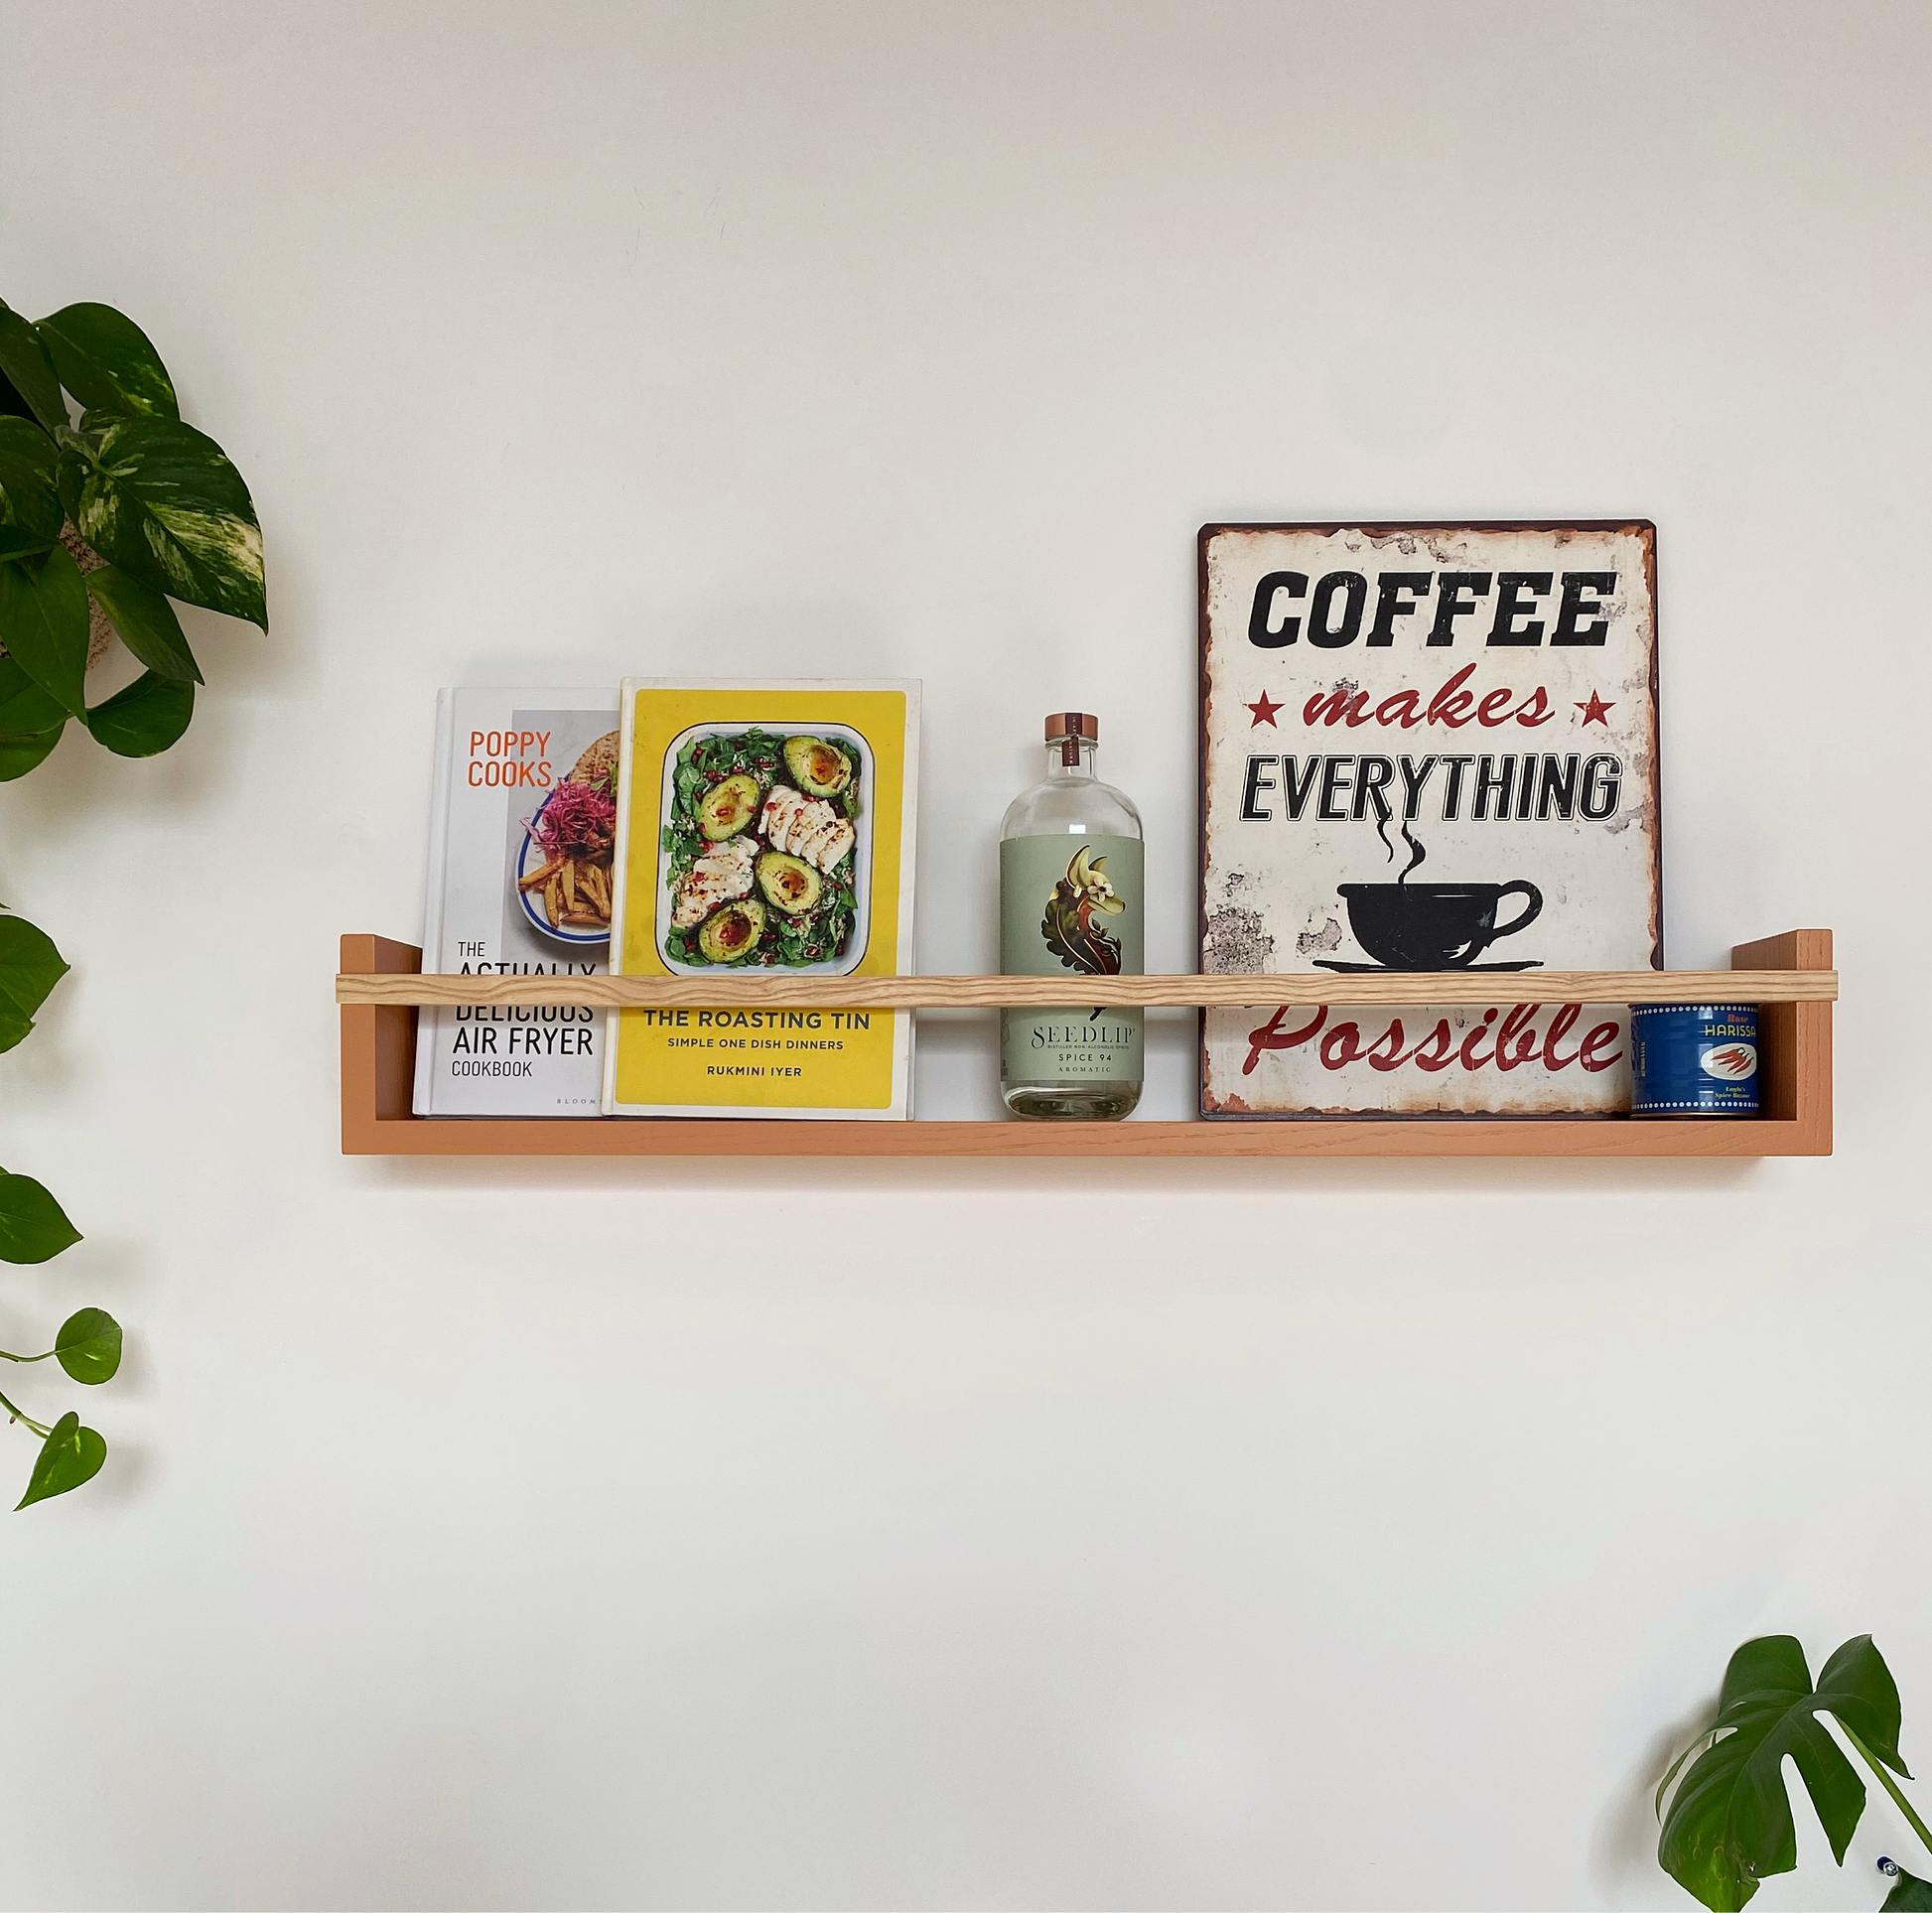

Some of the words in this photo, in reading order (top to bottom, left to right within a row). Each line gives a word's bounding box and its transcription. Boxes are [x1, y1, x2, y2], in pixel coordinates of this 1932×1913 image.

[1247, 570, 1617, 648] COFFEE
[1302, 662, 1556, 729] makes
[470, 731, 551, 757] POPPY
[468, 760, 552, 787] COOKS
[1239, 752, 1624, 822] EVERYTHING
[458, 941, 486, 957] THE
[643, 1009, 690, 1026] THE
[698, 1011, 822, 1028] ROASTING
[831, 1013, 870, 1029] TIN
[1705, 1025, 1756, 1037] HARISSA
[452, 1026, 497, 1054] AIR
[508, 1026, 594, 1055] FRYER
[667, 1037, 714, 1048] SIMPLE
[719, 1038, 746, 1048] ONE
[751, 1039, 781, 1049] DISH
[786, 1040, 844, 1050] DINNERS
[1031, 1025, 1133, 1049] SEEDLIP
[1241, 1003, 1623, 1075] Possible
[452, 1060, 533, 1077] COOKBOOK
[1058, 1053, 1093, 1062] SPICE
[707, 1065, 765, 1076] RUKMINI
[771, 1066, 802, 1077] IYER
